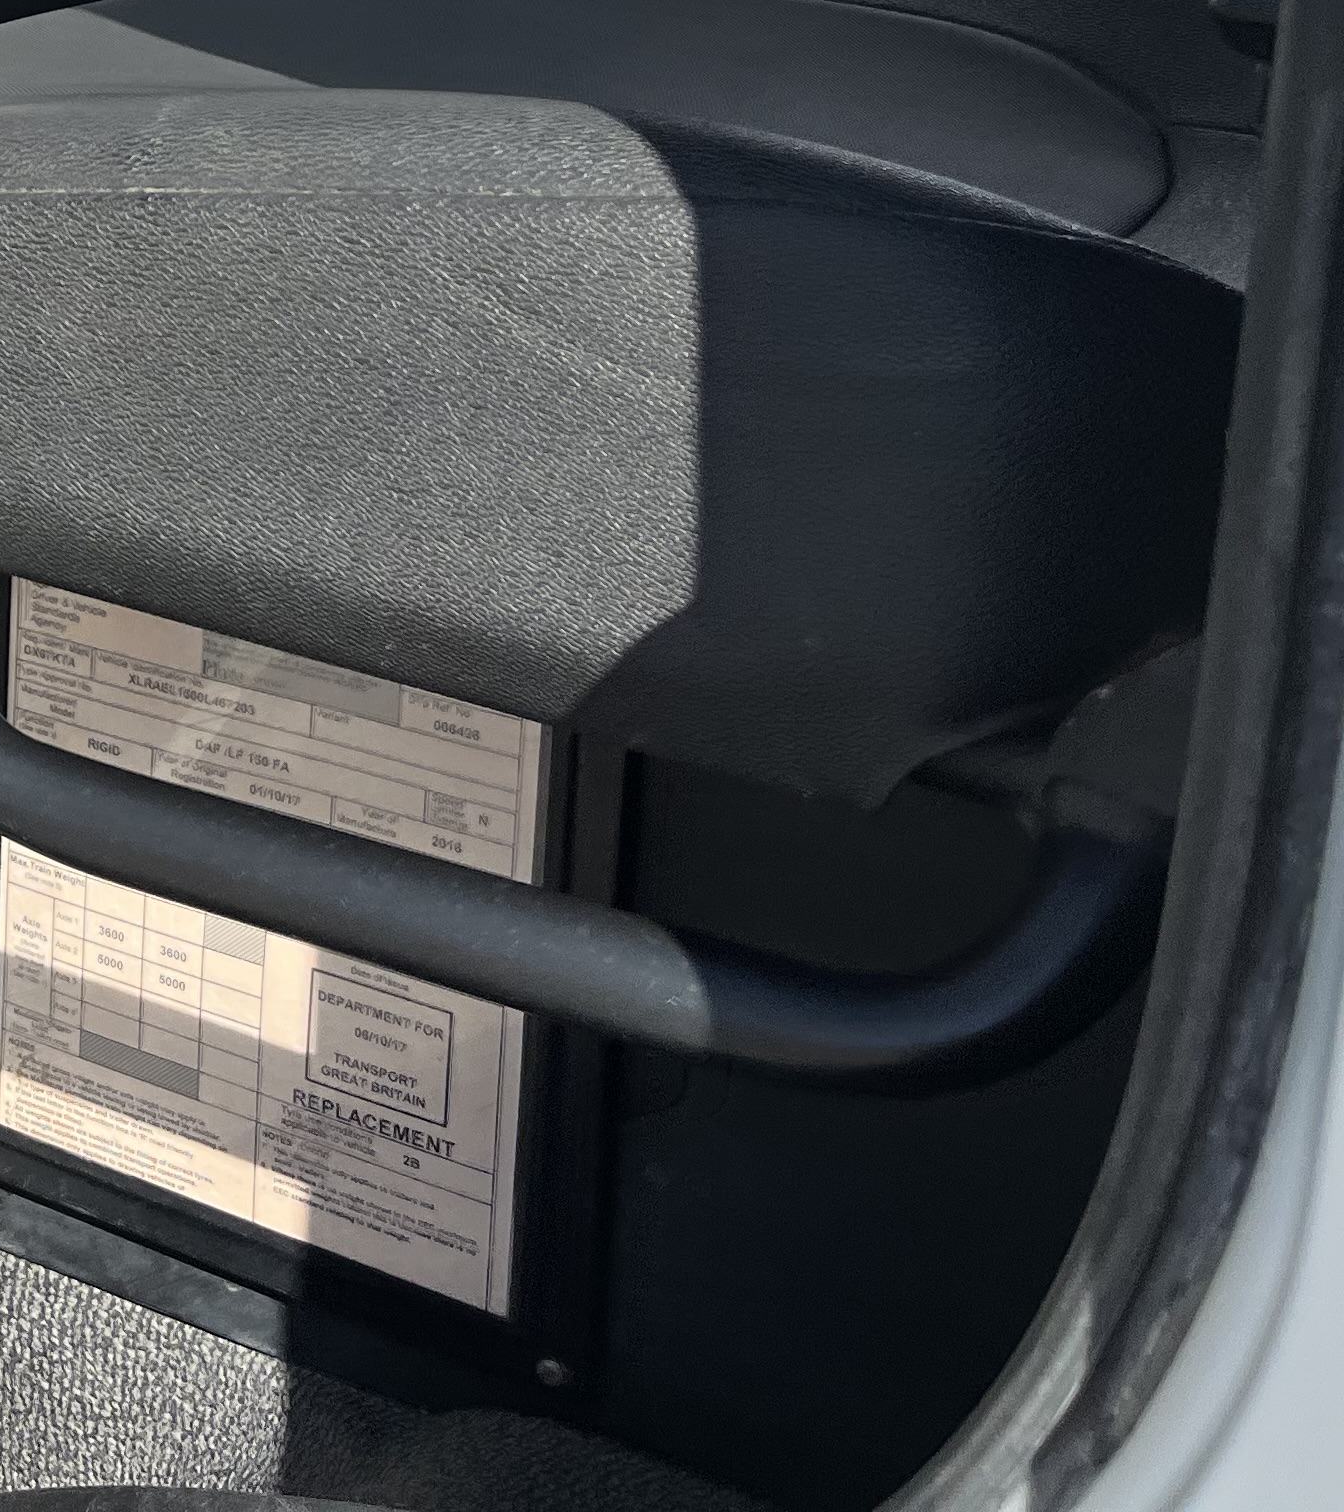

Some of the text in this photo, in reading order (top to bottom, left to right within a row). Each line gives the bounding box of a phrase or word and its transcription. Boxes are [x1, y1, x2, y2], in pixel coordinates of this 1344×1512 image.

[31, 601, 81, 623] Standards
[72, 599, 108, 617] Vehicle
[31, 615, 67, 632] Agency
[314, 706, 350, 725] Variant
[87, 738, 121, 756] RIGID
[30, 860, 52, 878] Train
[22, 915, 41, 929] Axle
[12, 921, 48, 943] Weights
[98, 925, 125, 942] 3600
[97, 954, 124, 971] 5000
[159, 945, 188, 963] 3600
[158, 974, 187, 992] 5000
[318, 989, 444, 1041] DEPARTMENT FOR
[334, 1052, 418, 1087] TRANSPORT
[320, 1065, 427, 1109] GREAT BRITAIN
[292, 1088, 456, 1158] REPLACEMENT
